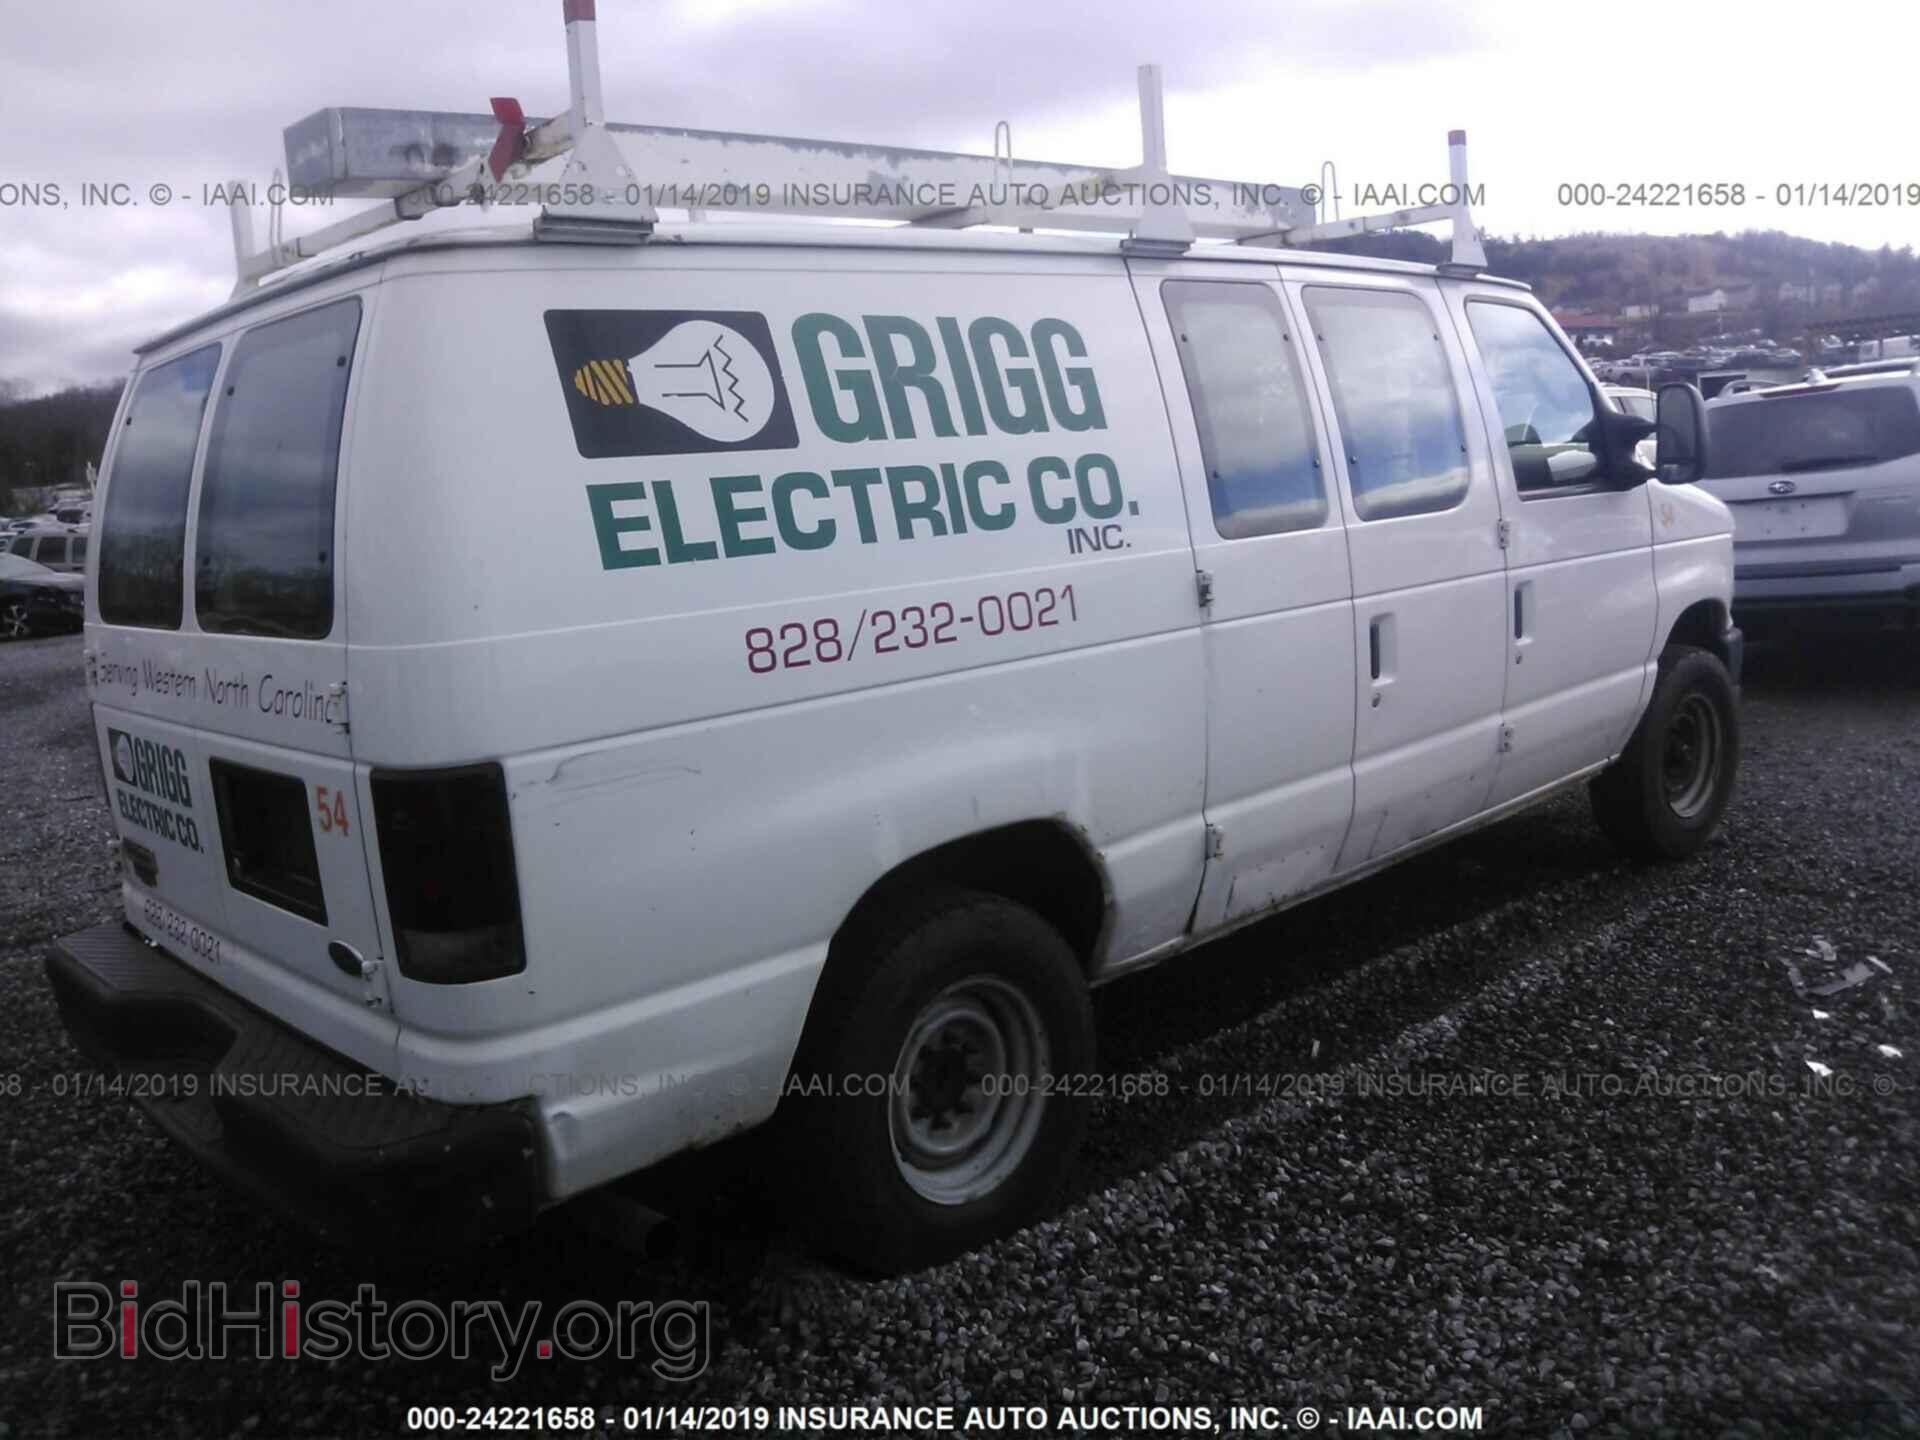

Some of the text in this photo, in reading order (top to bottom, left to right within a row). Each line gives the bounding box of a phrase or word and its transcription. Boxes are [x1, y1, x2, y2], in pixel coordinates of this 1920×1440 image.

[791, 312, 1108, 444] GRIGG
[586, 453, 1140, 571] ELECTRIC CO.
[1067, 524, 1132, 554] INC.
[745, 584, 1079, 674] 828/232-0021
[142, 658, 197, 697] Western
[206, 668, 249, 707] North
[133, 738, 193, 808] GRIGG
[117, 793, 204, 854] ELECTRIC CO.
[315, 786, 350, 836] 54
